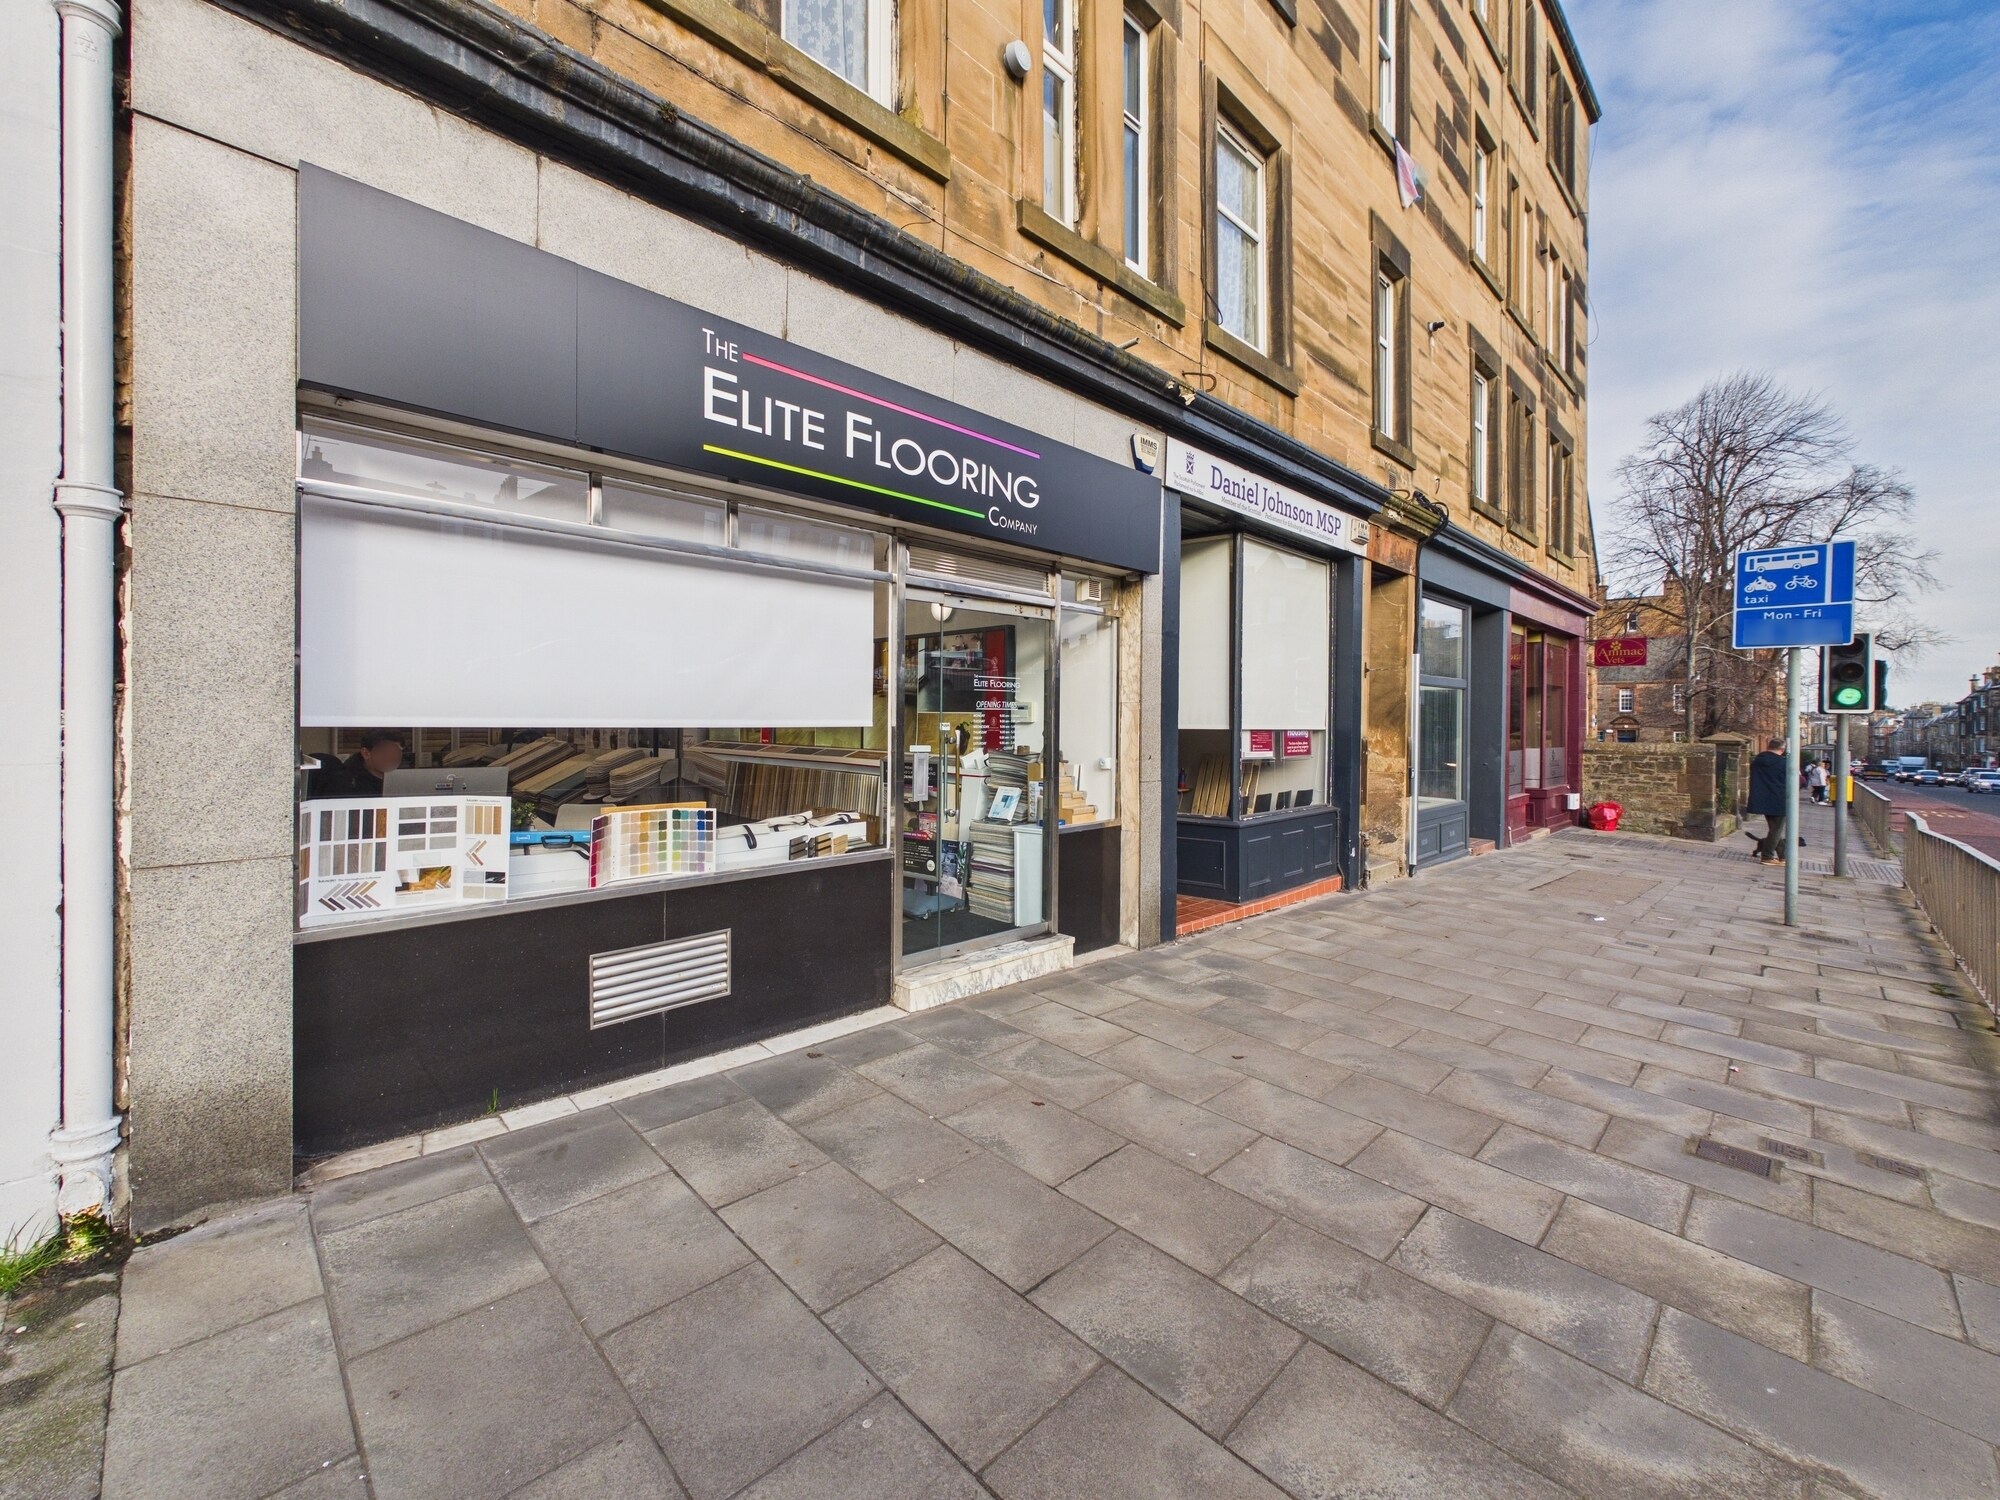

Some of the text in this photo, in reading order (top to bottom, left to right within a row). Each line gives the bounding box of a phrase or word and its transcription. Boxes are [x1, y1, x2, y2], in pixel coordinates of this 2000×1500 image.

[704, 366, 1040, 509] ELITE FLOORING
[1210, 465, 1342, 536] Daniel Johnson MSP
[1744, 594, 1769, 604] taxi
[1763, 611, 1793, 620] Mon
[1803, 609, 1822, 618] Fri
[1605, 656, 1626, 664] Vets
[976, 700, 1001, 709] OPENING
